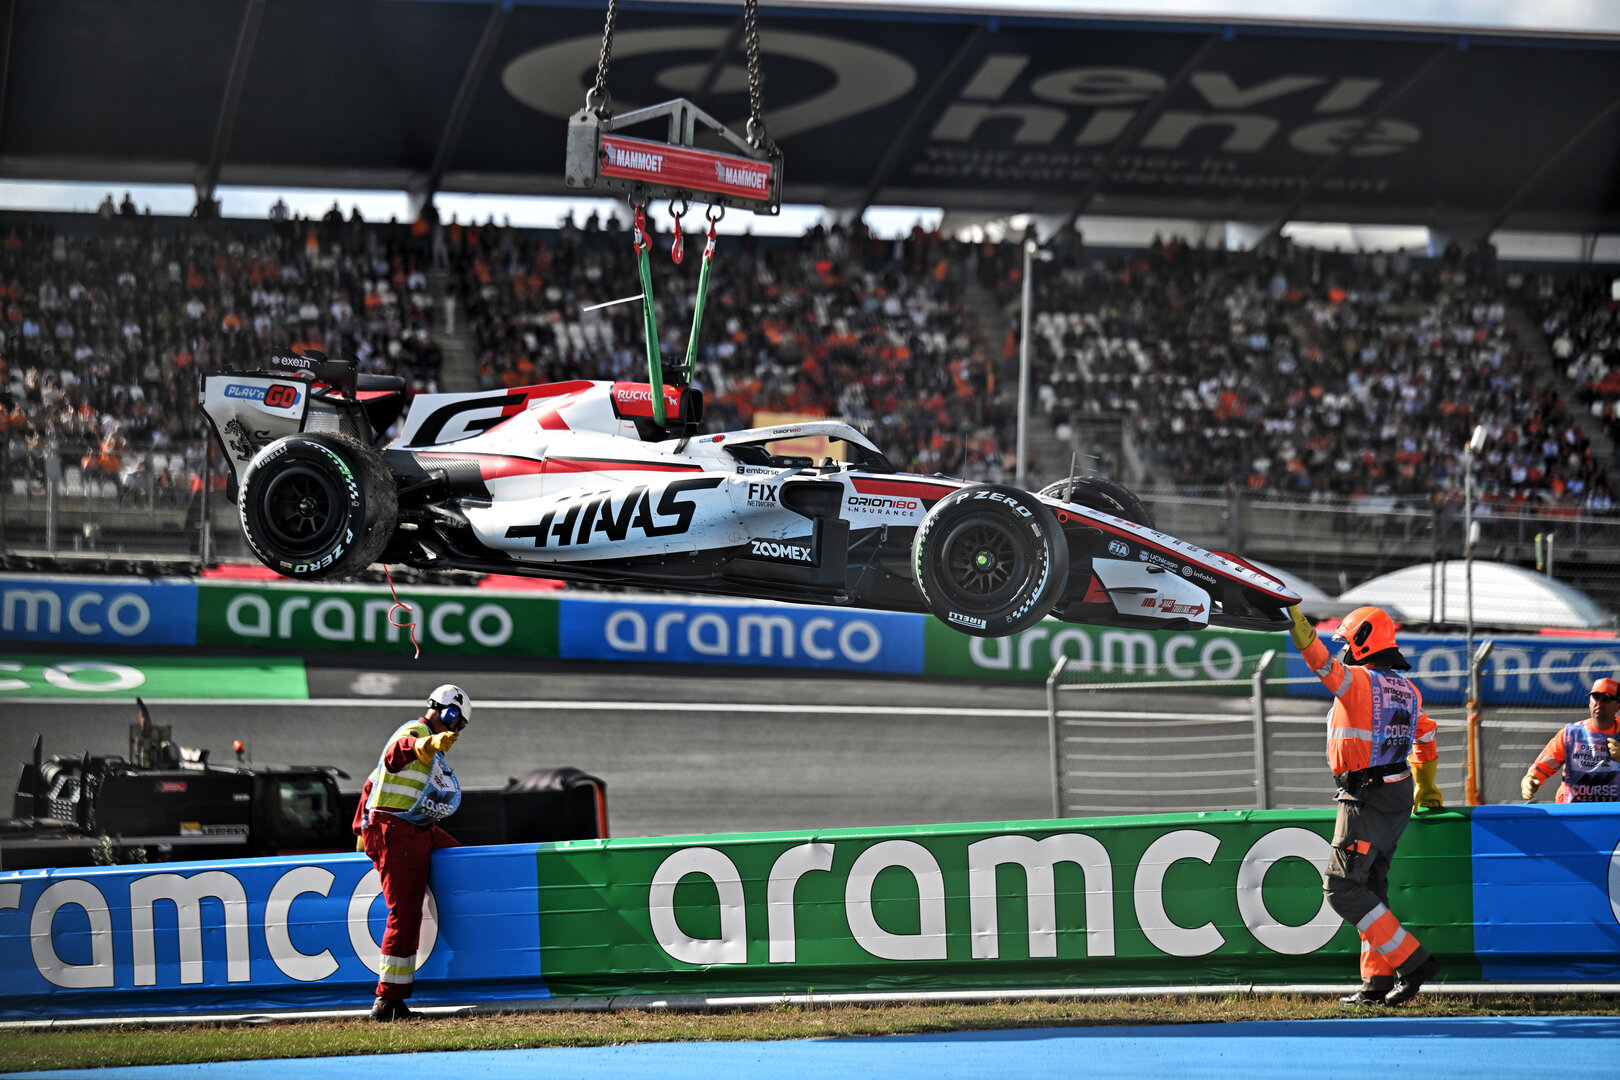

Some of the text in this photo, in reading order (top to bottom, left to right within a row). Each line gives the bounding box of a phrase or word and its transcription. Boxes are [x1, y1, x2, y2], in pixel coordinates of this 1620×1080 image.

[962, 53, 1384, 112] levi
[930, 103, 1422, 157] nine
[616, 149, 663, 172] MAMMOET
[725, 167, 767, 190] MAMMOET
[266, 385, 298, 407] GO
[617, 389, 653, 401] RUCKU
[256, 442, 288, 470] PIRELLI
[745, 467, 780, 476] emburse
[749, 483, 778, 501] FIX
[847, 496, 918, 510] ORION180
[504, 477, 726, 548] HAAS
[747, 500, 776, 508] NETWORK
[848, 506, 915, 517] INSURANCE
[973, 491, 1032, 518] ZERO
[751, 540, 812, 562] ZOOMEX
[1109, 541, 1127, 554] FIA
[294, 549, 344, 574] ZERO
[1149, 553, 1179, 569] UChicago
[1193, 570, 1217, 585] infobip
[226, 593, 513, 648] aramco
[948, 611, 987, 630] PIRELLI
[605, 609, 882, 664] aramco
[969, 627, 1243, 680] aramco
[1572, 784, 1618, 797] COURSE
[648, 827, 1342, 965] aramco
